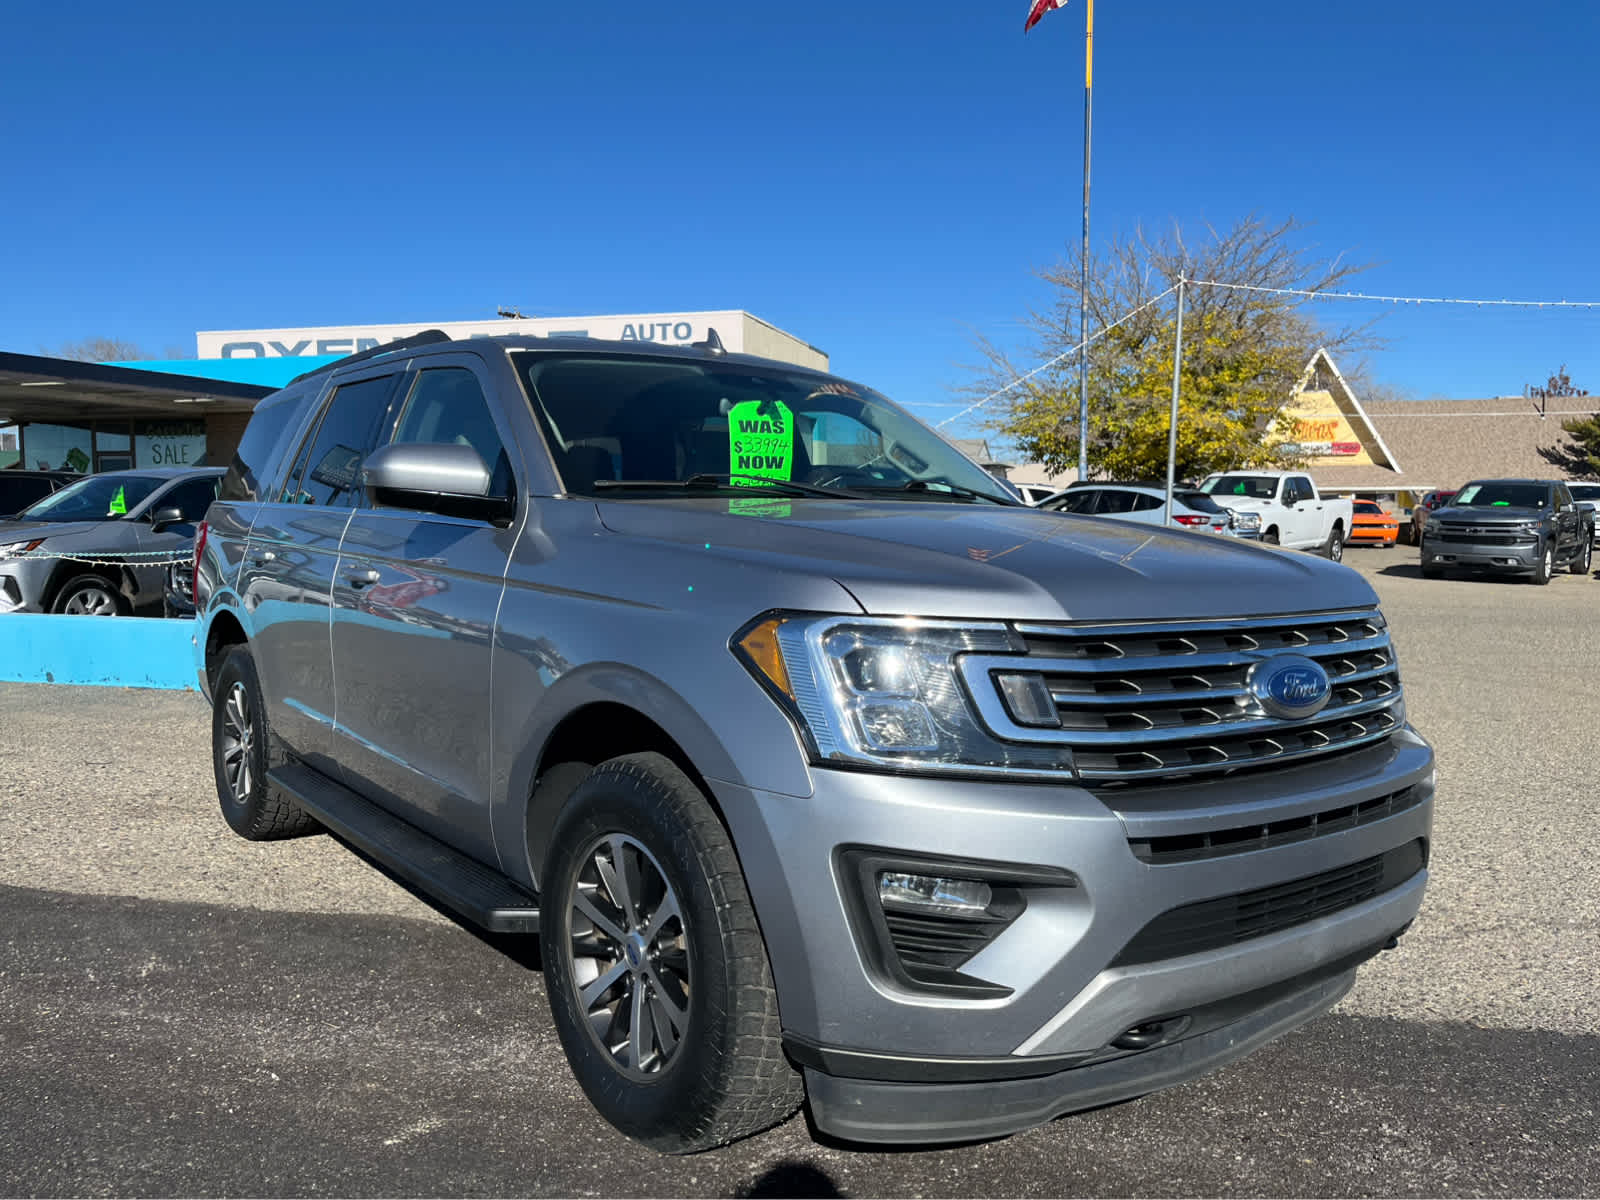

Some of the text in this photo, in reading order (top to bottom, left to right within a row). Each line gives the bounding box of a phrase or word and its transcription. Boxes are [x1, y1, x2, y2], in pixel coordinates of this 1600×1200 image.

[621, 322, 693, 341] AUTO
[738, 420, 785, 434] WAS
[151, 443, 190, 465] SALE
[738, 455, 784, 470] NOW
[1283, 672, 1320, 699] Ford
